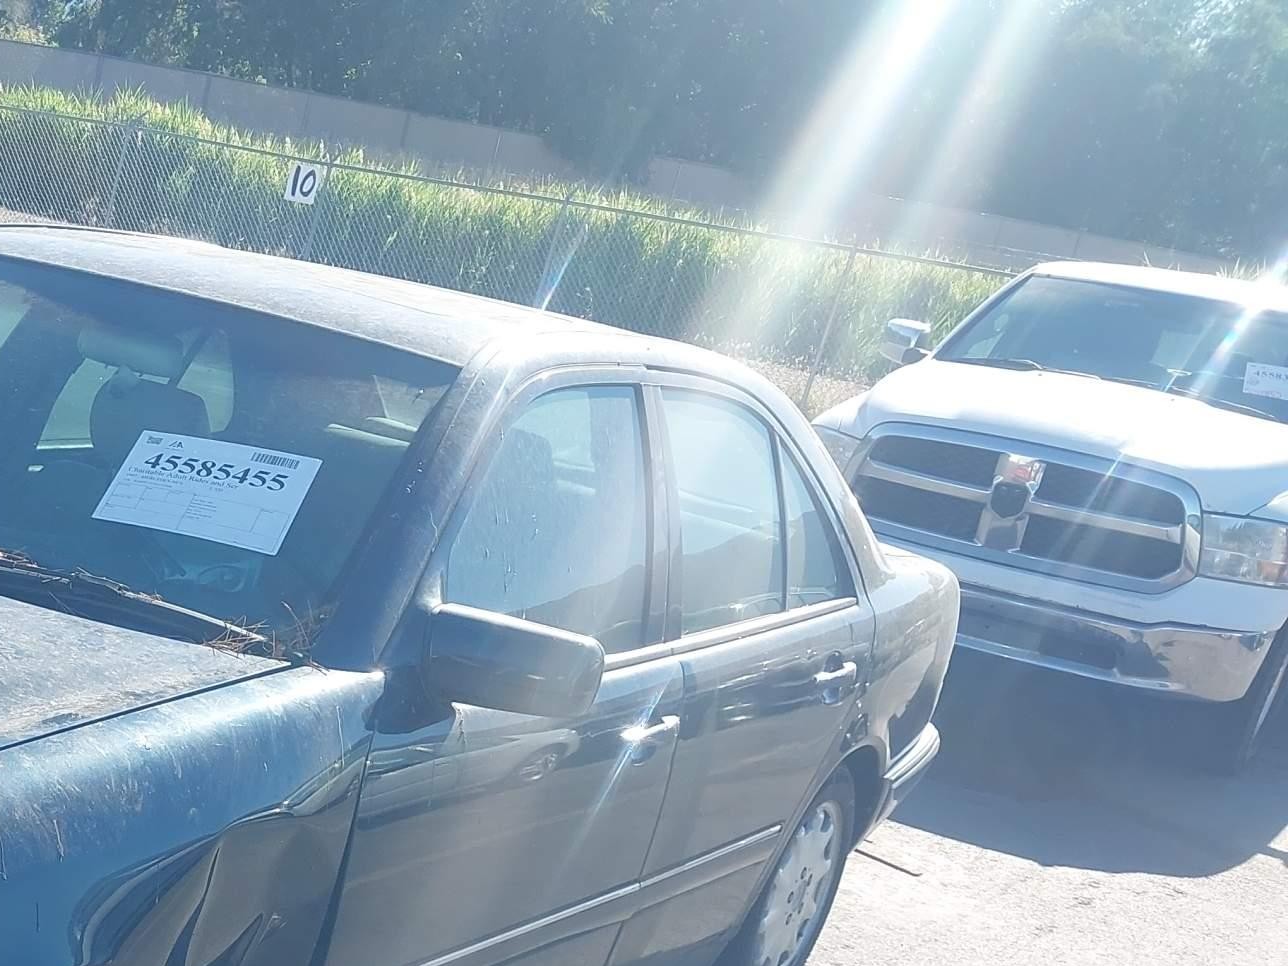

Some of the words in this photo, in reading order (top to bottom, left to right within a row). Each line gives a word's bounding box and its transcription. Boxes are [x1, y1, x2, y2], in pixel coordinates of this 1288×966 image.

[291, 165, 316, 197] 10
[144, 453, 289, 492] 45585455
[166, 472, 187, 481] Adult
